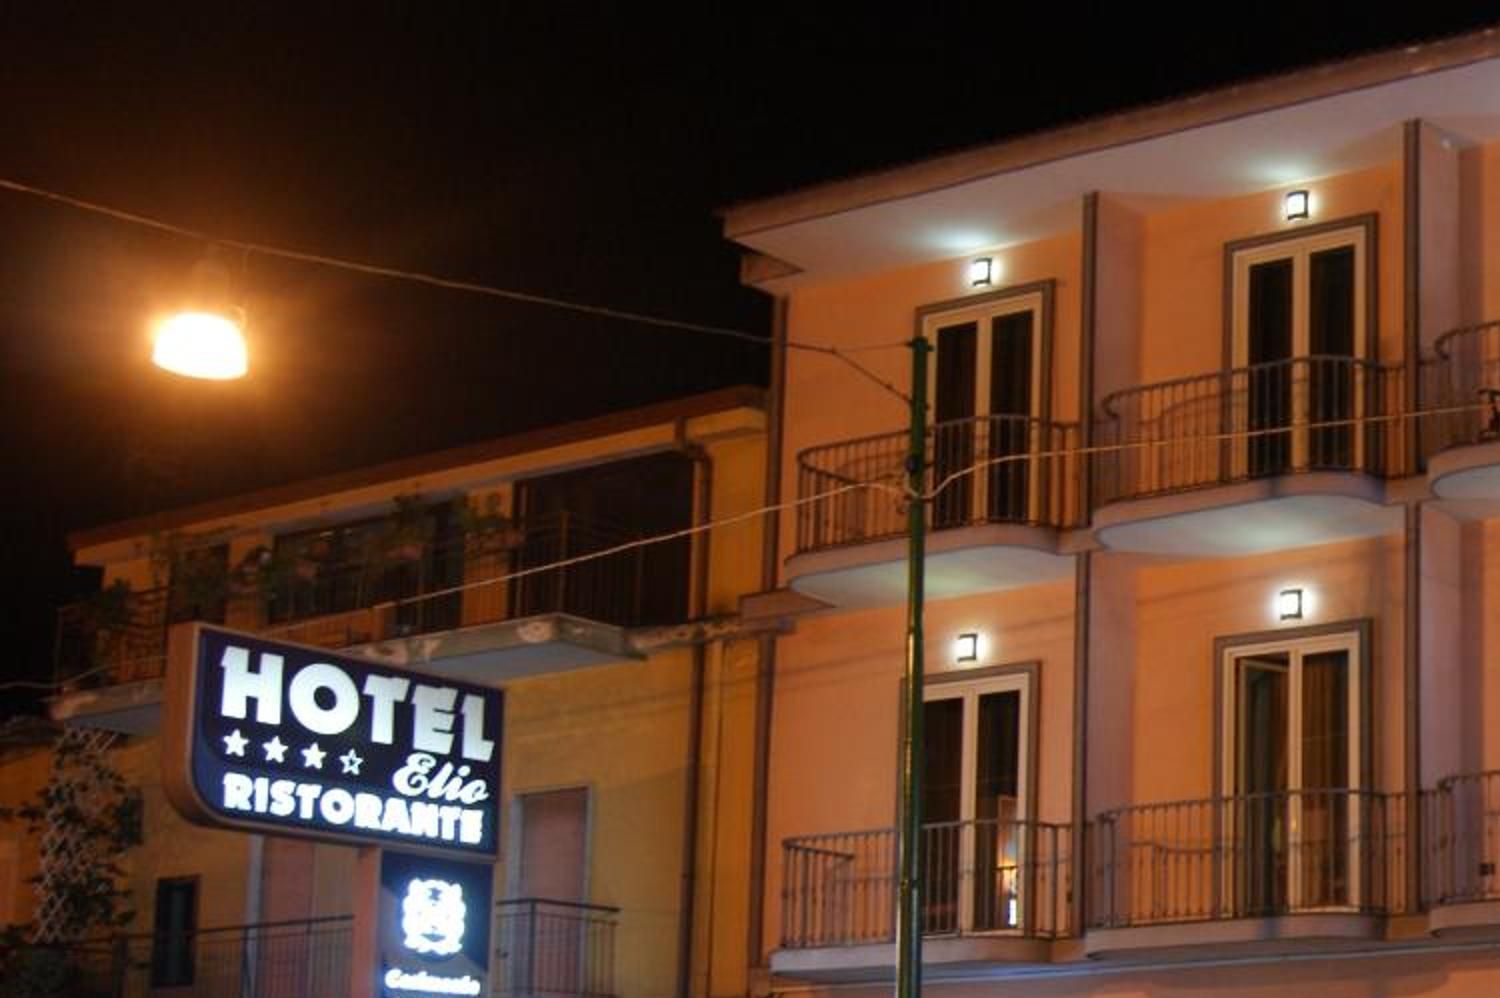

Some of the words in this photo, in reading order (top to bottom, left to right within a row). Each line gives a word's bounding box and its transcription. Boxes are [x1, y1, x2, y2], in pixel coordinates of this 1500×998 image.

[221, 645, 495, 762] HOTEL
[223, 772, 484, 845] RISTORANTE
[393, 752, 490, 805] Elio
